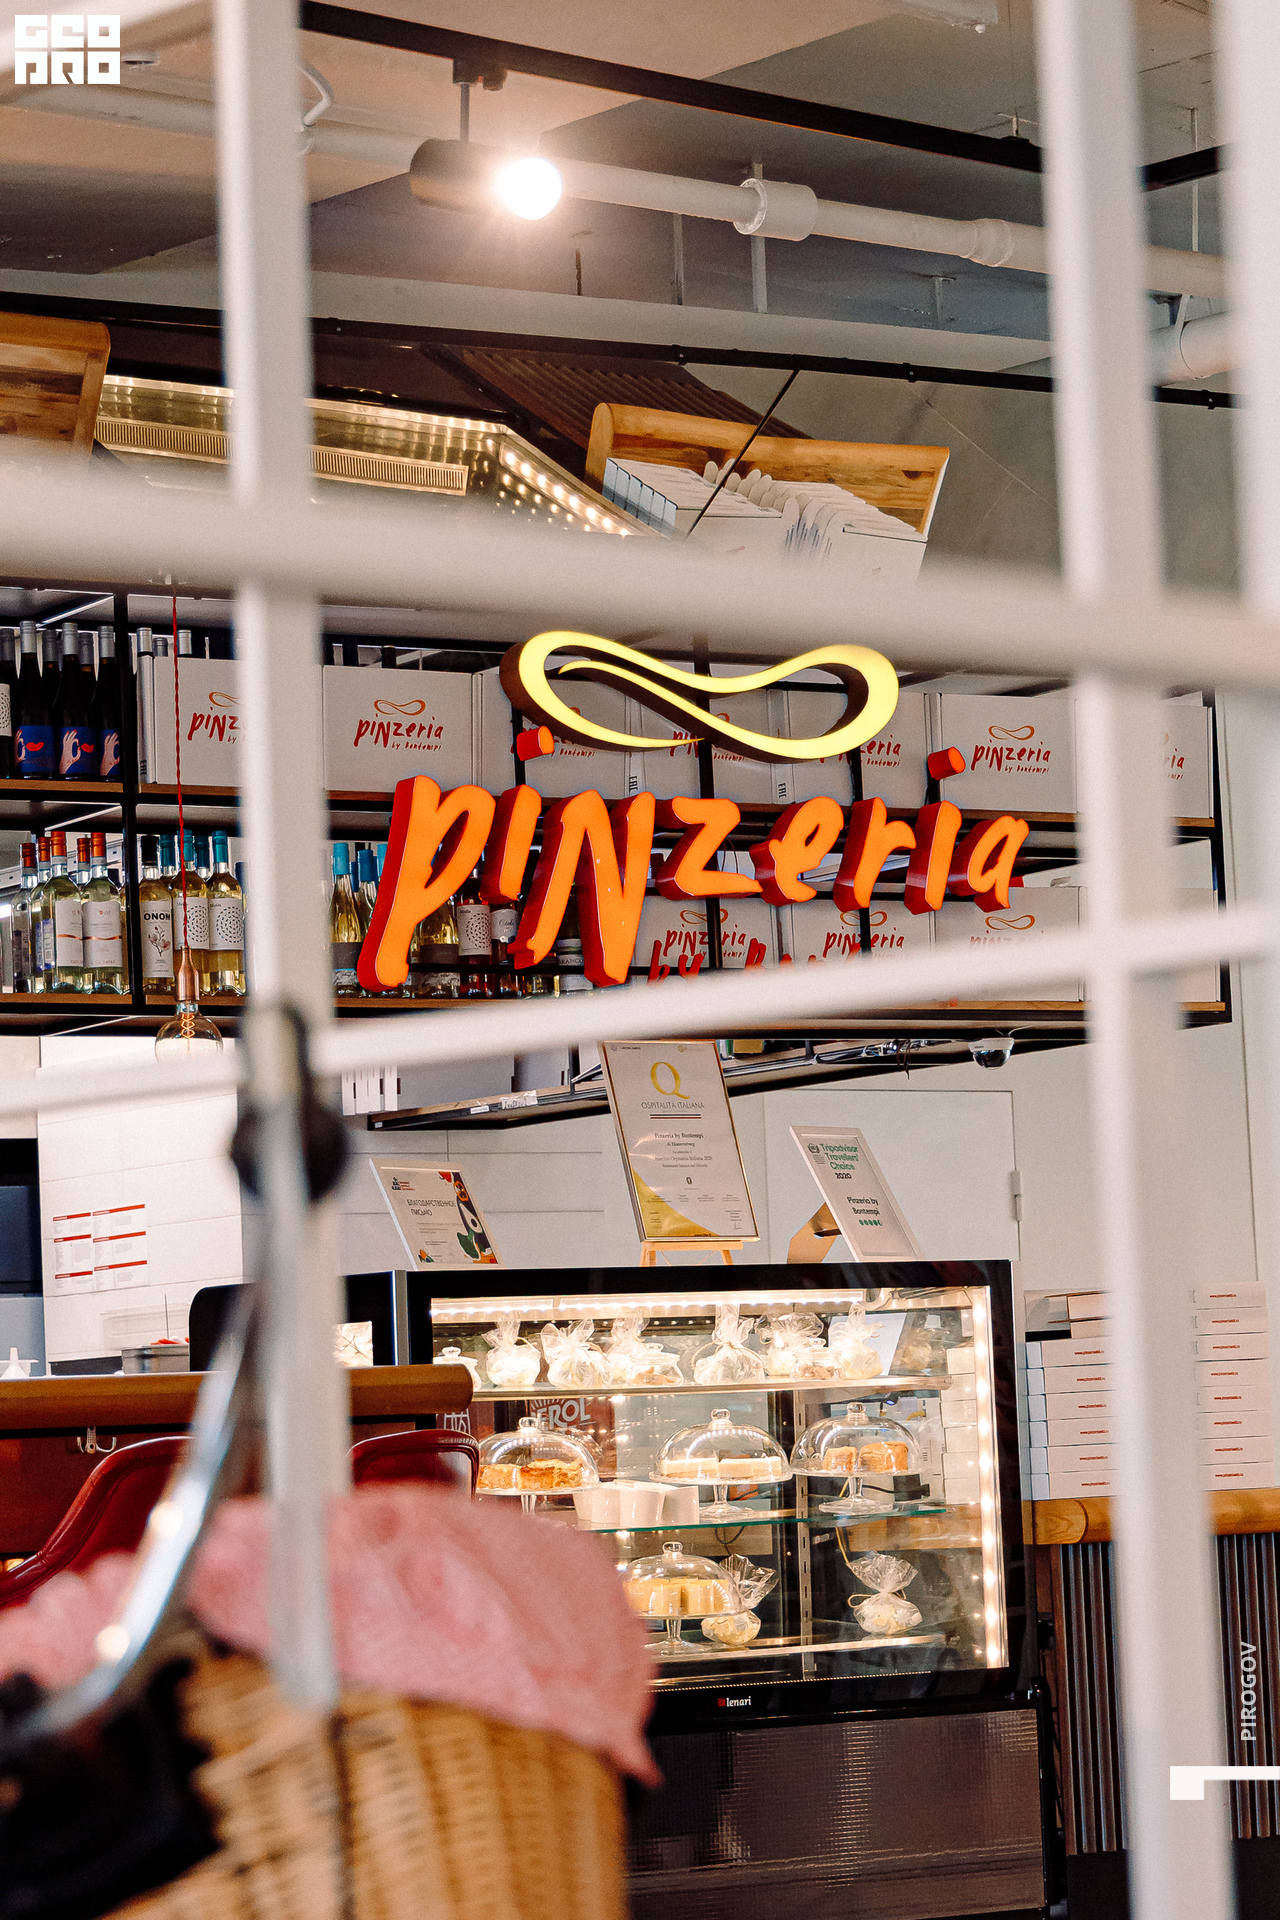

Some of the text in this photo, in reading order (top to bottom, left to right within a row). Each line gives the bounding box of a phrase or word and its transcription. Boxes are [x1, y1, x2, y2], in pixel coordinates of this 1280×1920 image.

[391, 741, 442, 751] by Bontempi
[1004, 764, 1050, 773] by Bontempi
[650, 1061, 690, 1099] Q
[677, 1101, 705, 1109] ITALIANA
[820, 1143, 858, 1153] Tripadvisor
[829, 1162, 856, 1170] Choice
